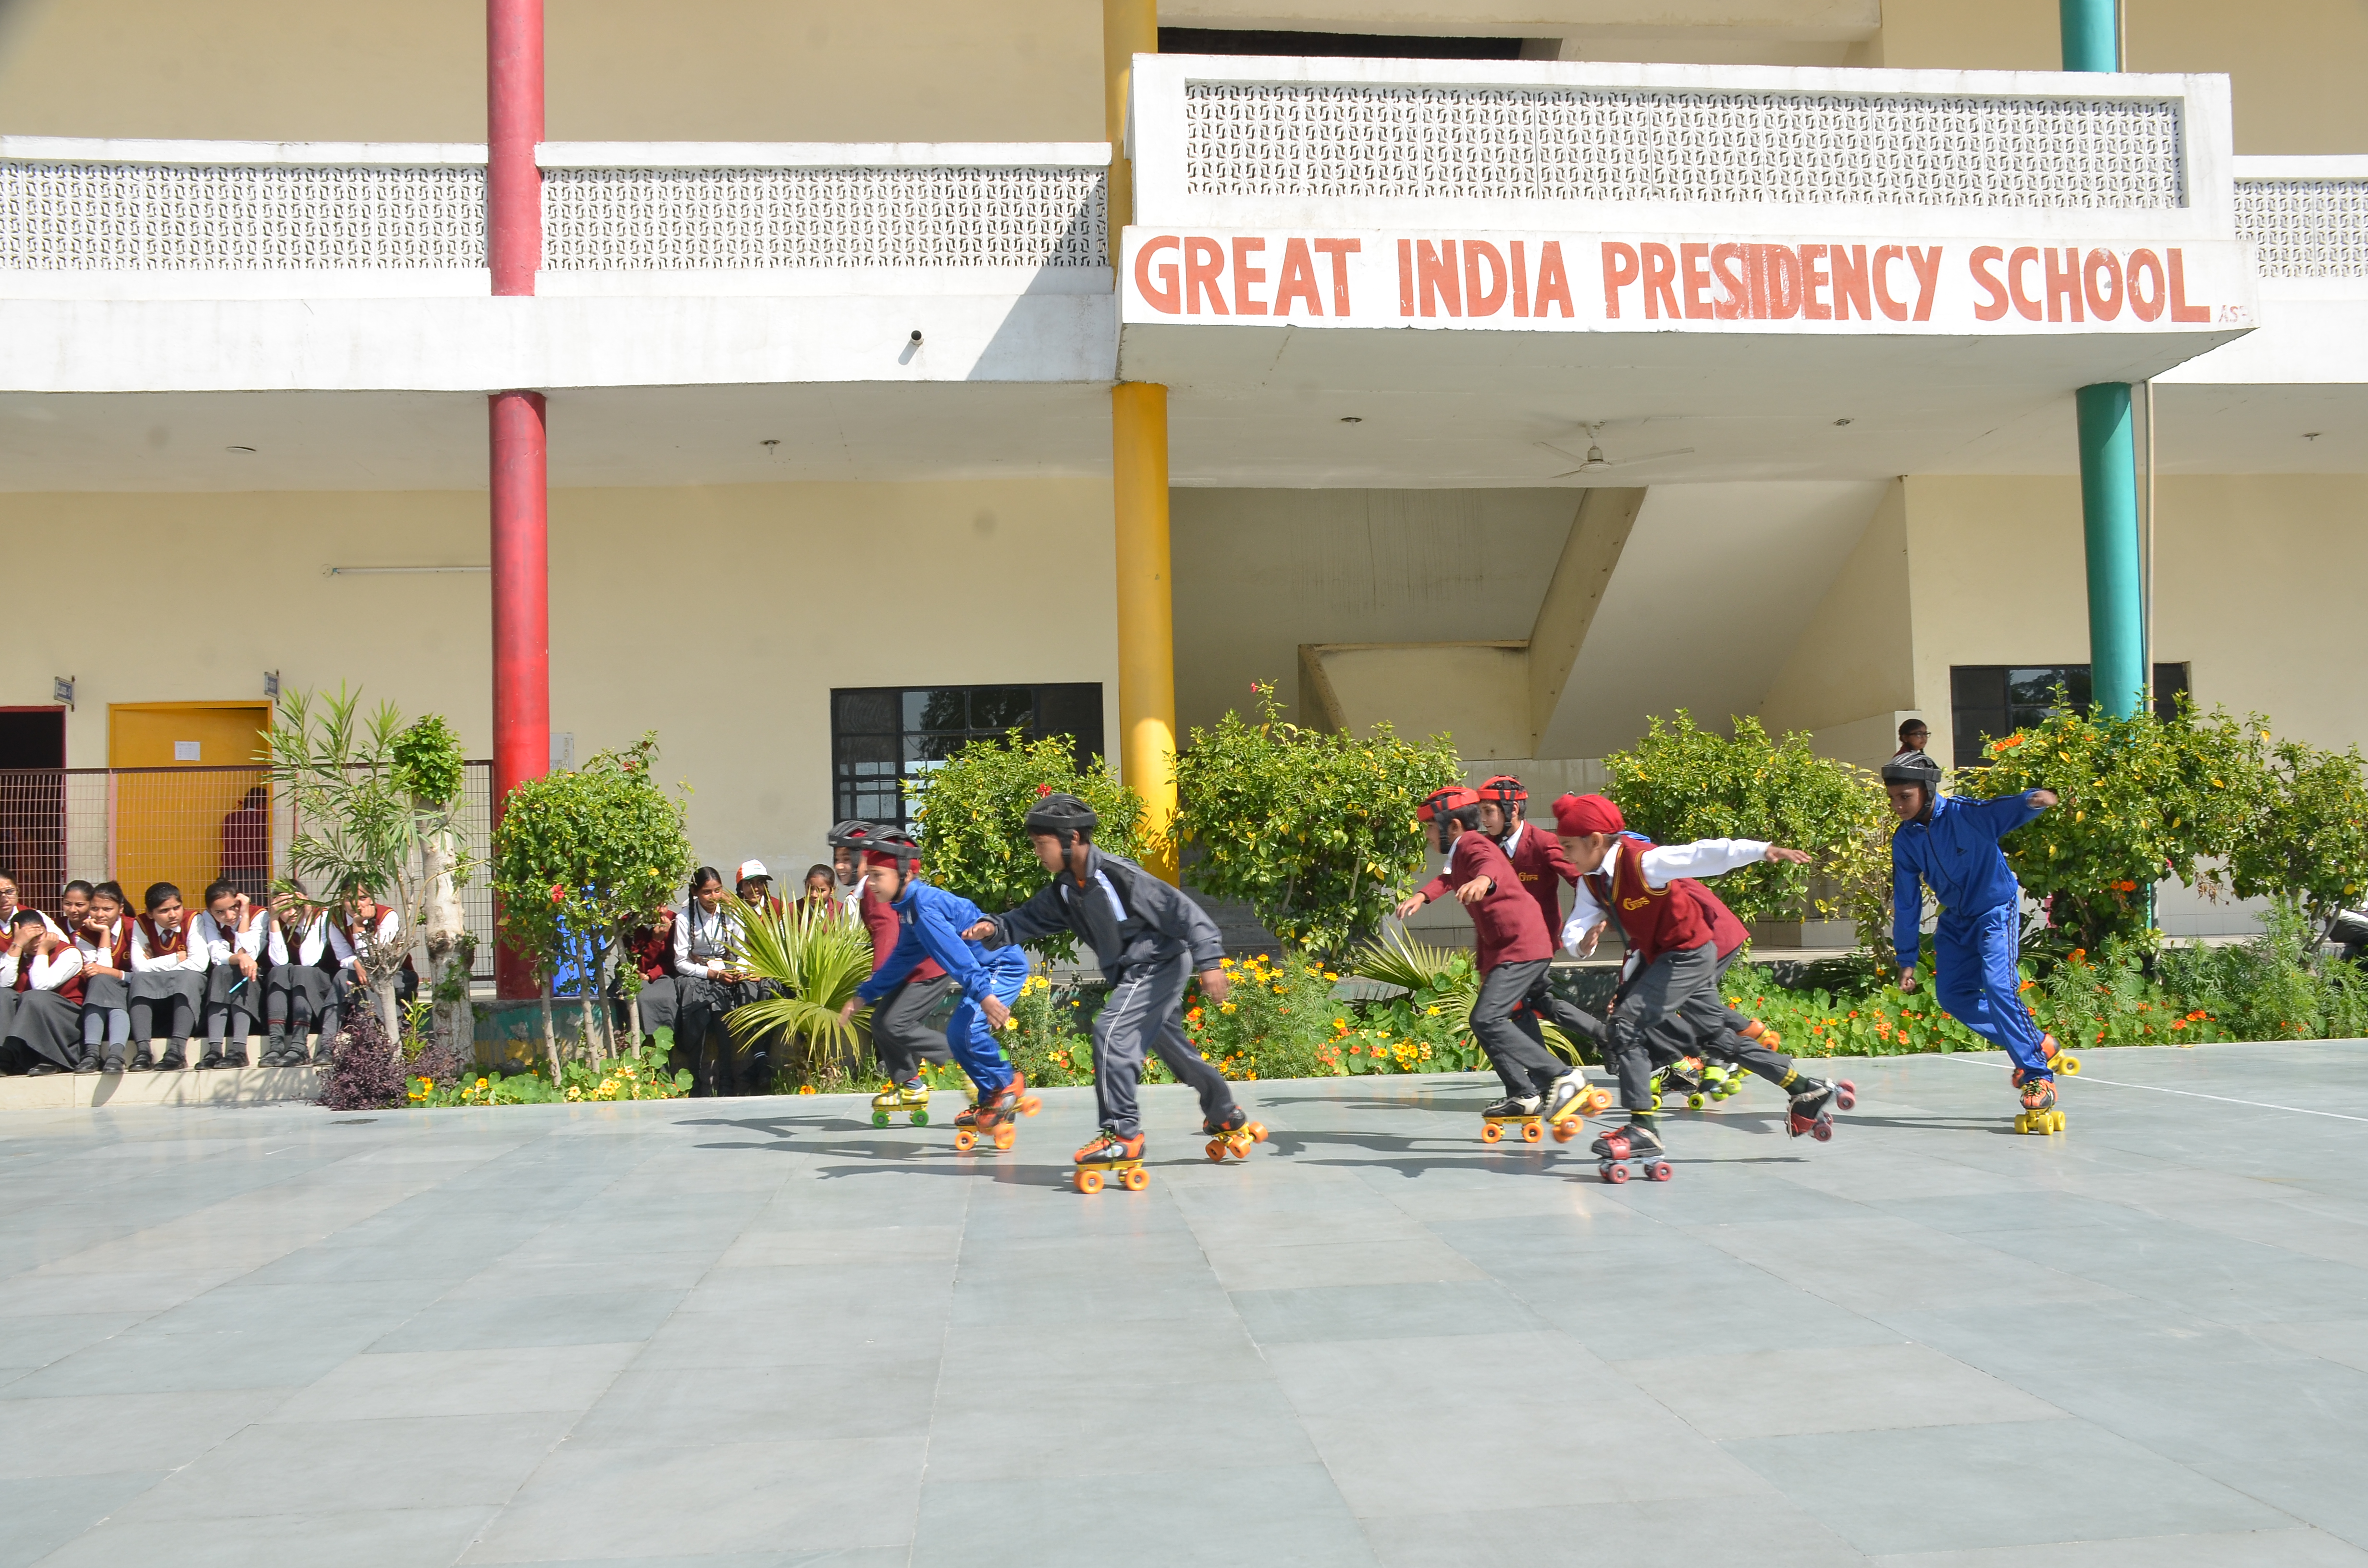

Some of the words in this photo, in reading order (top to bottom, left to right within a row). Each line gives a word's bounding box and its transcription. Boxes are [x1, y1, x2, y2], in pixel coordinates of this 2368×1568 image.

[1135, 235, 1361, 317] GREAT
[1397, 239, 1575, 318] INDIA
[1602, 241, 1943, 321] PRESIDENCY
[1970, 245, 2210, 323] SCHOOL
